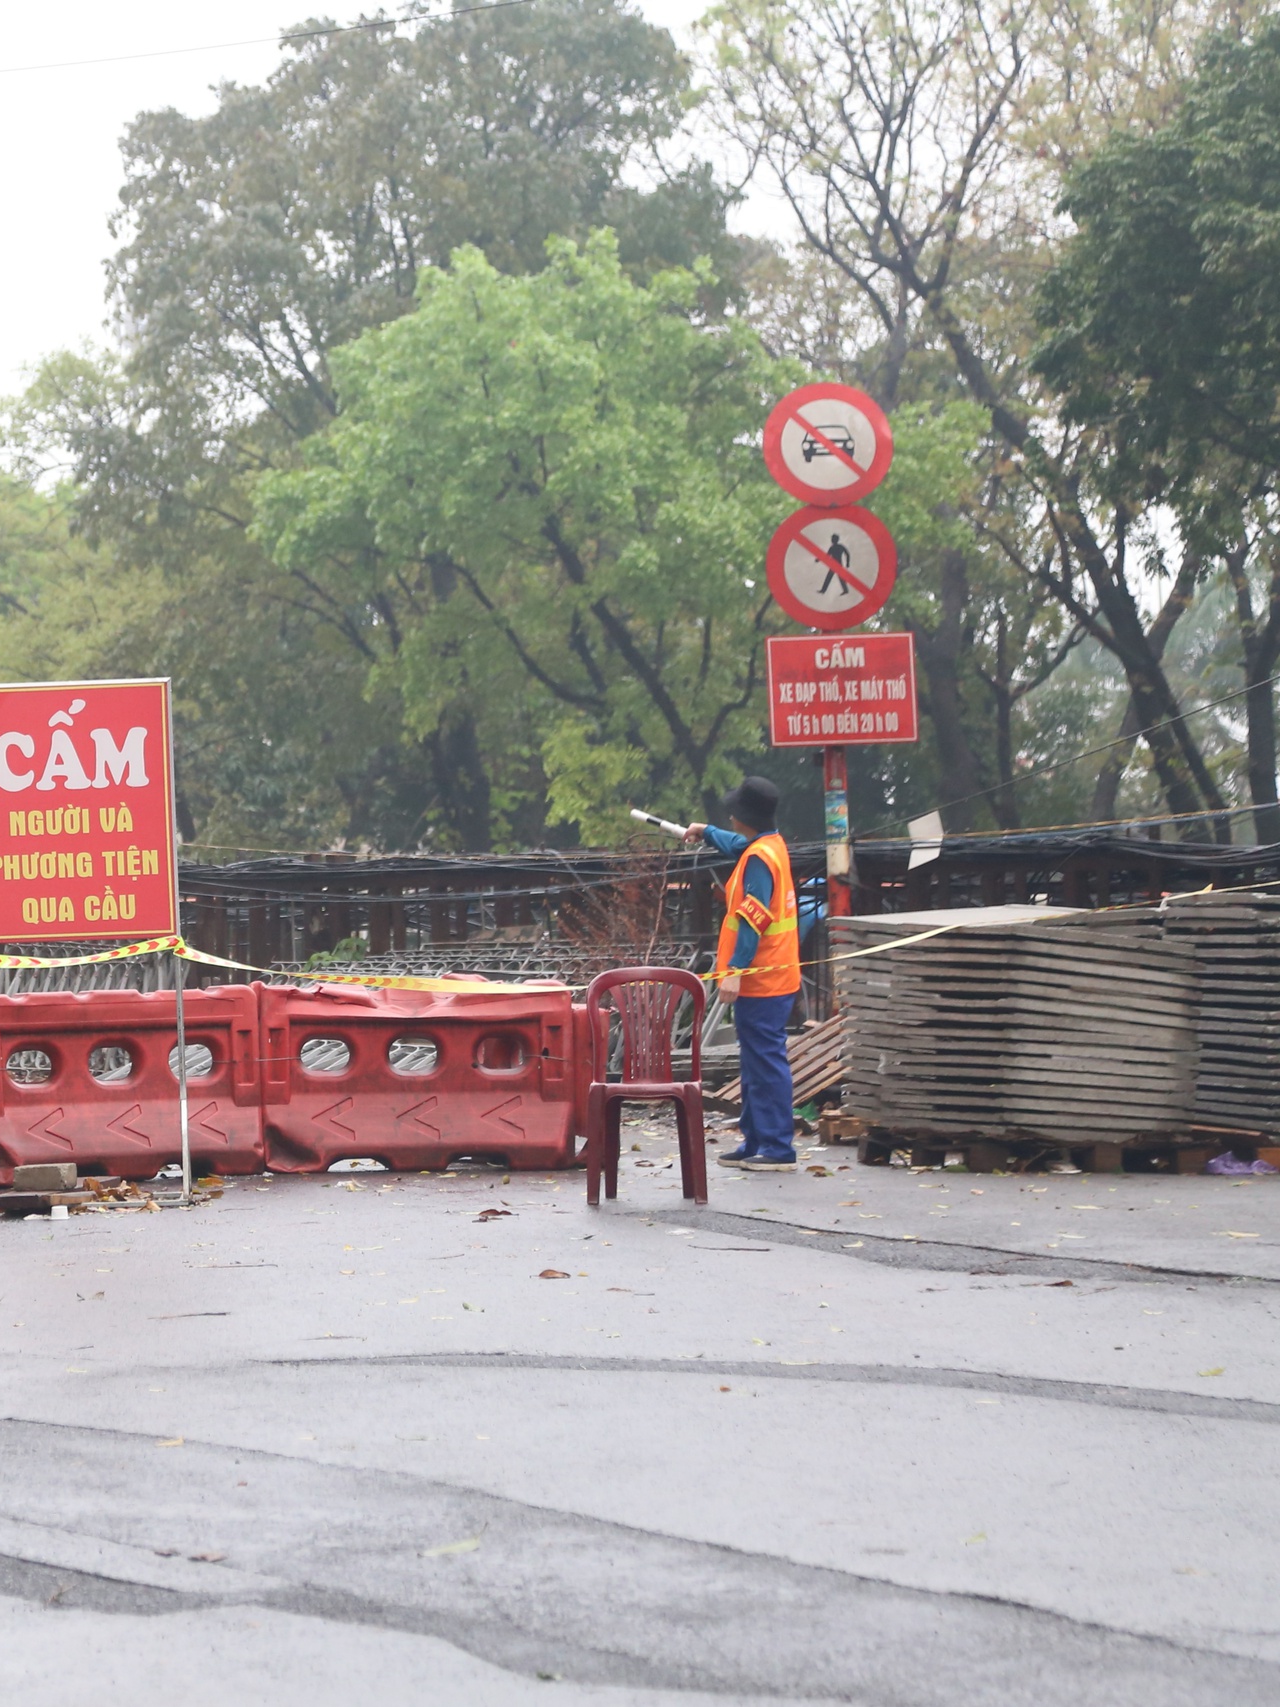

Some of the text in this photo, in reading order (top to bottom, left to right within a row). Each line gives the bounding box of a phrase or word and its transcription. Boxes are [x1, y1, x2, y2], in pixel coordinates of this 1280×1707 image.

[815, 641, 866, 669] CẤM
[779, 682, 793, 703] XE
[795, 681, 817, 707] ĐẠP
[844, 680, 859, 701] XE
[860, 676, 884, 701] MÁY
[803, 715, 810, 736] 5
[821, 714, 835, 734] 00
[836, 707, 858, 733] ĐẾN
[860, 712, 874, 733] 20
[885, 712, 899, 732] 00
[9, 802, 133, 836] NGƯỜI VÀ
[102, 845, 159, 881] TIỆN
[22, 885, 136, 924] QUA CẦU
